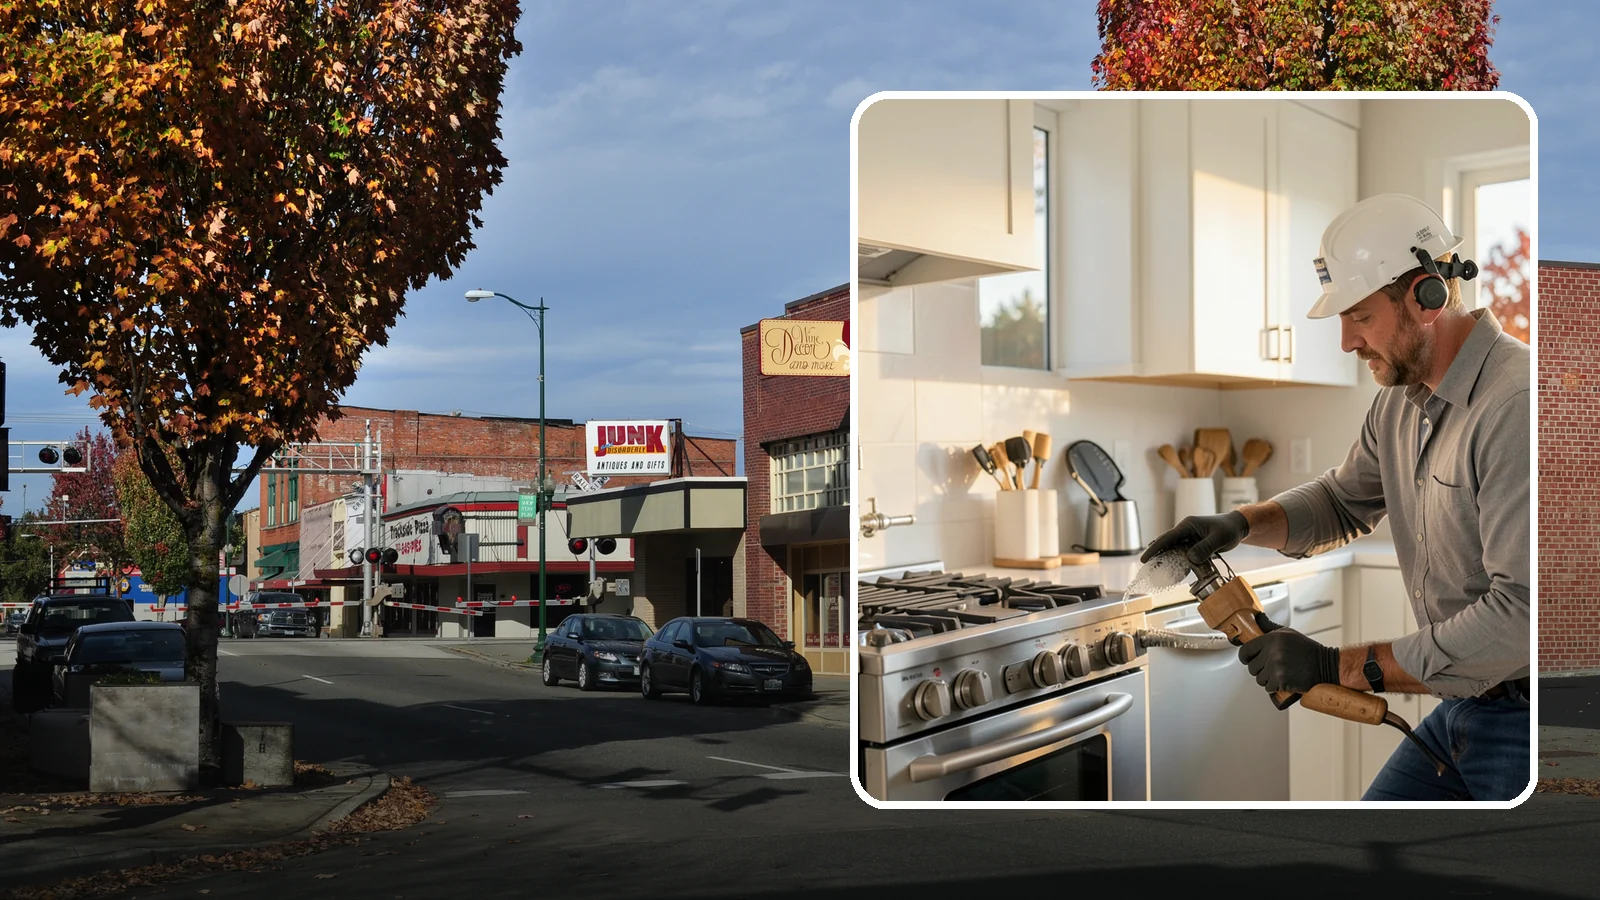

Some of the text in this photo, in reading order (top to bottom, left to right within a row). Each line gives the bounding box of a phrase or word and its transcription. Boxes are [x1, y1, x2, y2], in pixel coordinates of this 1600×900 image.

[765, 328, 831, 365] Decor
[595, 425, 666, 457] JUNK
[607, 446, 646, 454] DISORDERLY
[597, 460, 666, 470] ANTIQUES AND GIFTS
[573, 473, 588, 491] RAIL
[352, 498, 365, 510] CRO
[414, 519, 429, 535] Pizza
